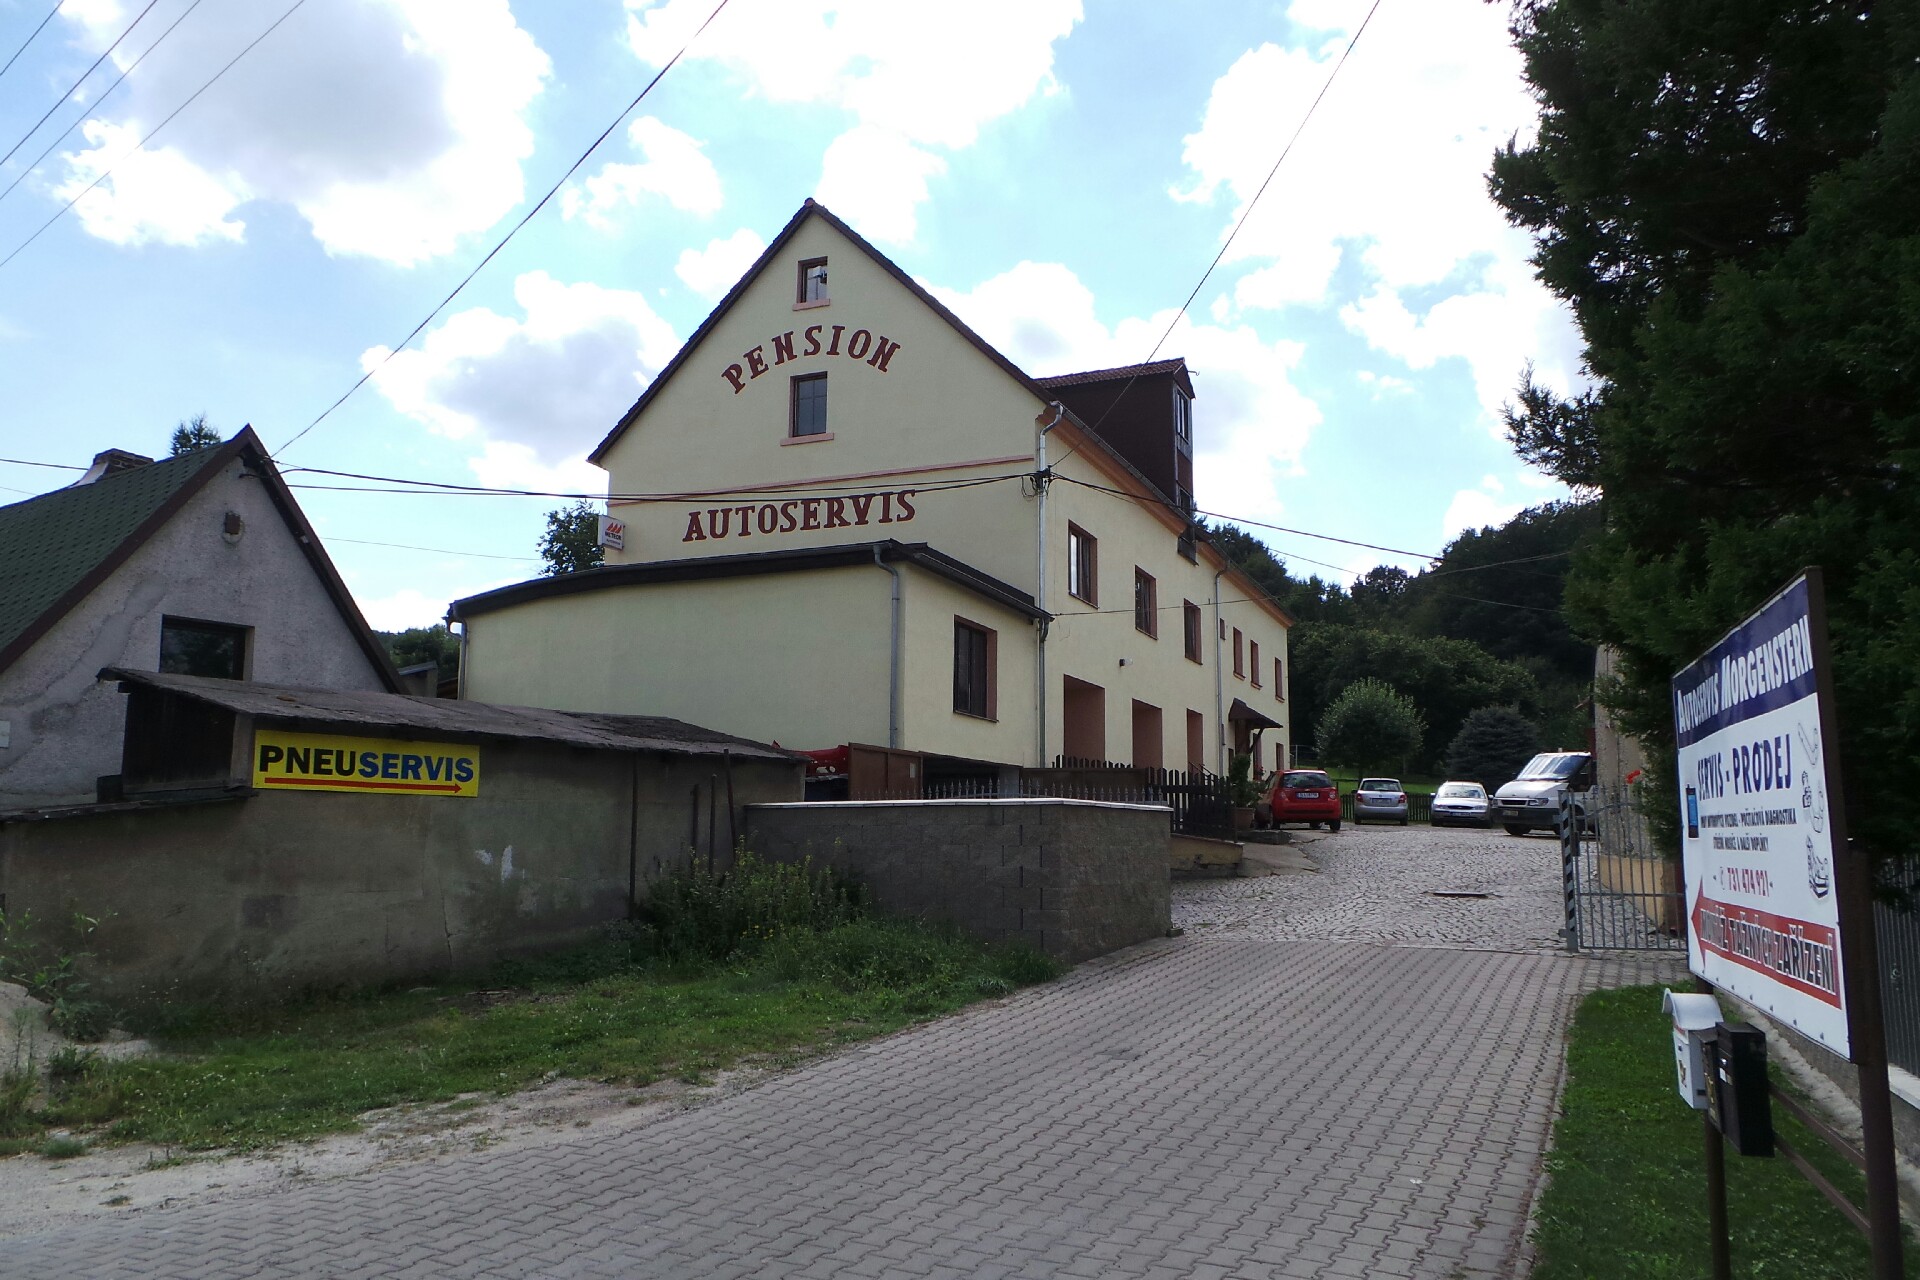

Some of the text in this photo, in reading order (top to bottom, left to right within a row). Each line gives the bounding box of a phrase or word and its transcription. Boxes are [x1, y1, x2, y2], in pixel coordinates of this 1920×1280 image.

[720, 325, 901, 394] PENSION
[682, 489, 917, 542] AUTOSERVIS
[1721, 615, 1813, 711] MORGENSTERN
[259, 744, 474, 783] PNEUSERVIS
[1697, 752, 1724, 802] SERVIS
[1732, 734, 1793, 795] PRODEJ
[1727, 867, 1740, 891] 731
[1741, 868, 1755, 894] 474
